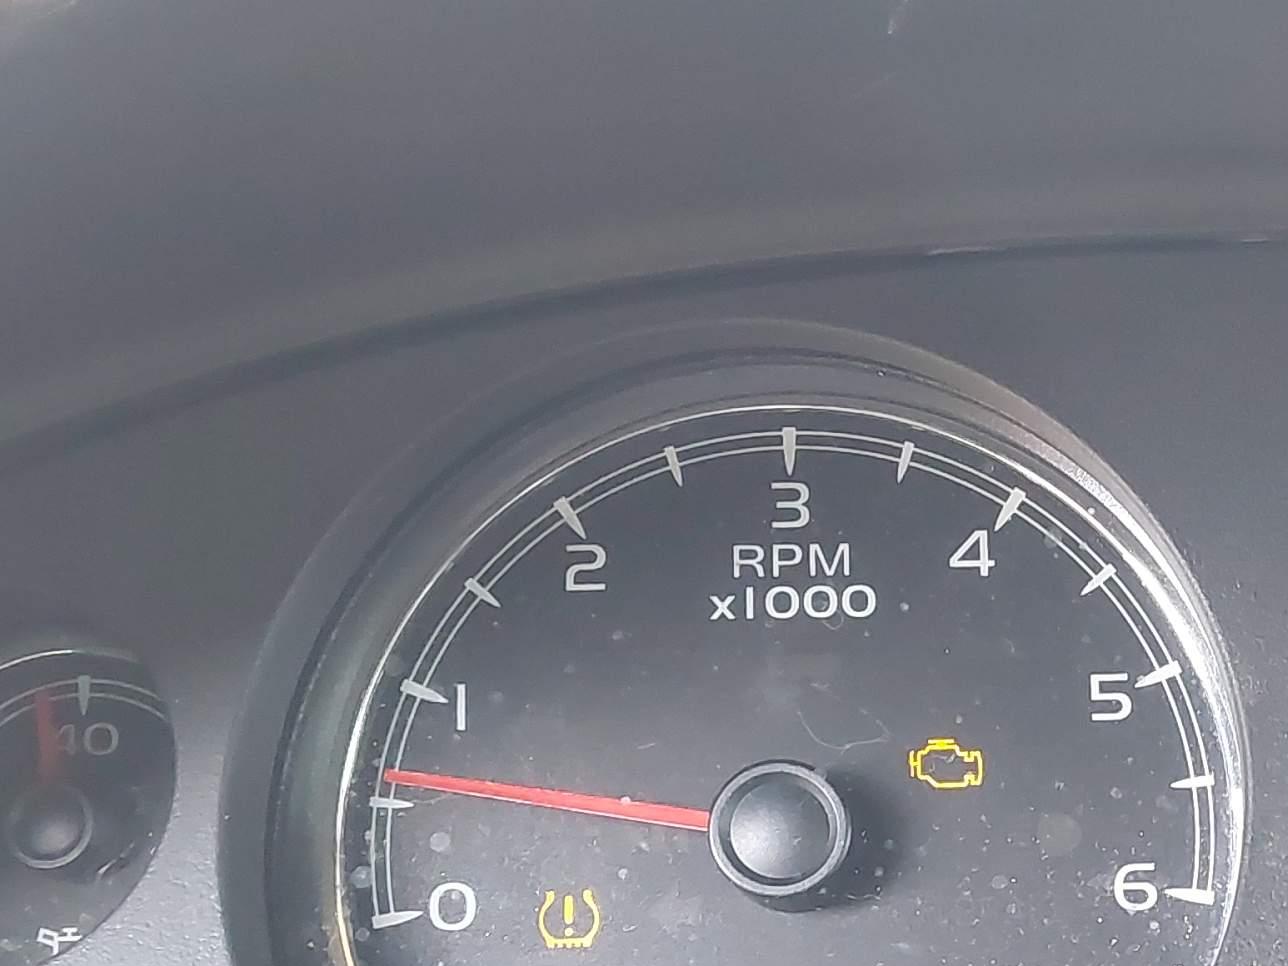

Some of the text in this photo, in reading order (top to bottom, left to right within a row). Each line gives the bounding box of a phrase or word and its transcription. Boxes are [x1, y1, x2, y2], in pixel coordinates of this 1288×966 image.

[770, 482, 810, 529] 3
[565, 544, 606, 591] 2
[732, 543, 850, 578] RPM
[949, 530, 995, 577] 4
[709, 585, 876, 620] x1000
[457, 683, 465, 730] 1
[1089, 673, 1132, 721] 5
[429, 882, 476, 930] 0
[1113, 863, 1158, 910] 6
